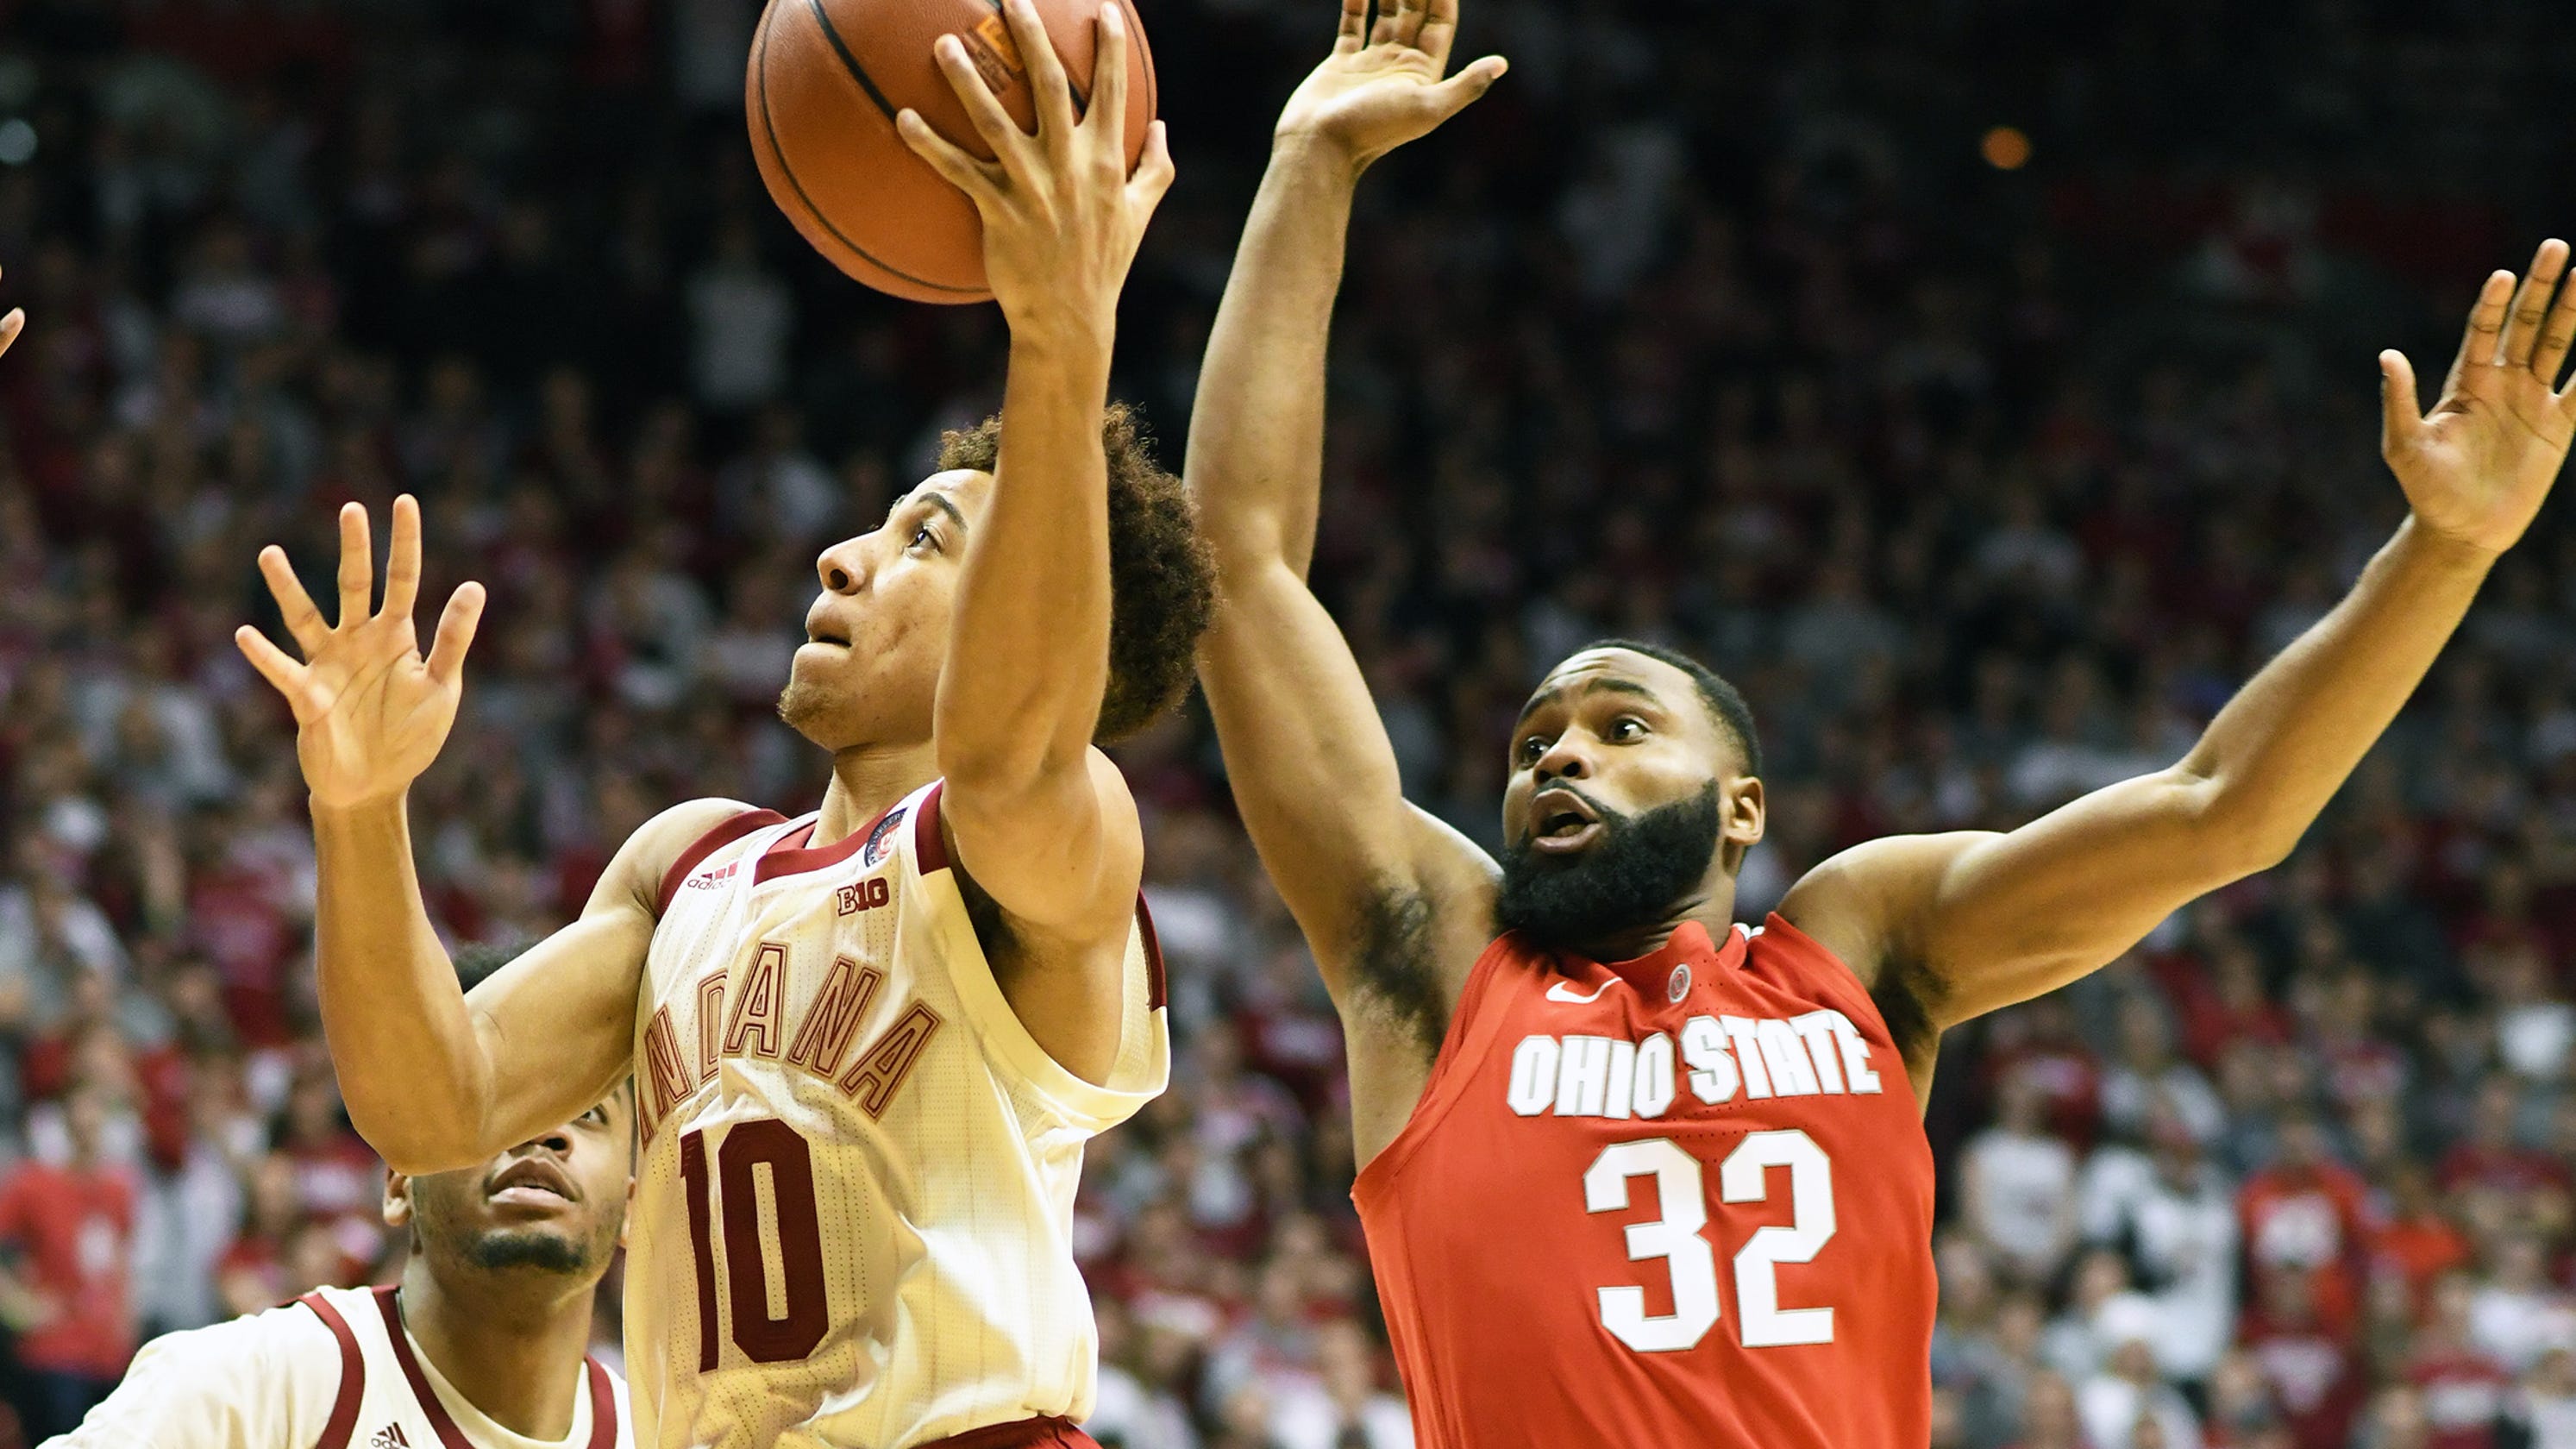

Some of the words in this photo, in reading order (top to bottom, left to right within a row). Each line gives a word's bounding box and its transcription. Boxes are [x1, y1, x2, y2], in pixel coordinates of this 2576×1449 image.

[687, 876, 731, 890] adida
[636, 942, 943, 1151] INDANA
[1507, 1032, 1676, 1120] OHIO
[1679, 1009, 1883, 1105] STATE
[680, 1118, 830, 1374] 10
[1583, 1128, 1837, 1352] 32
